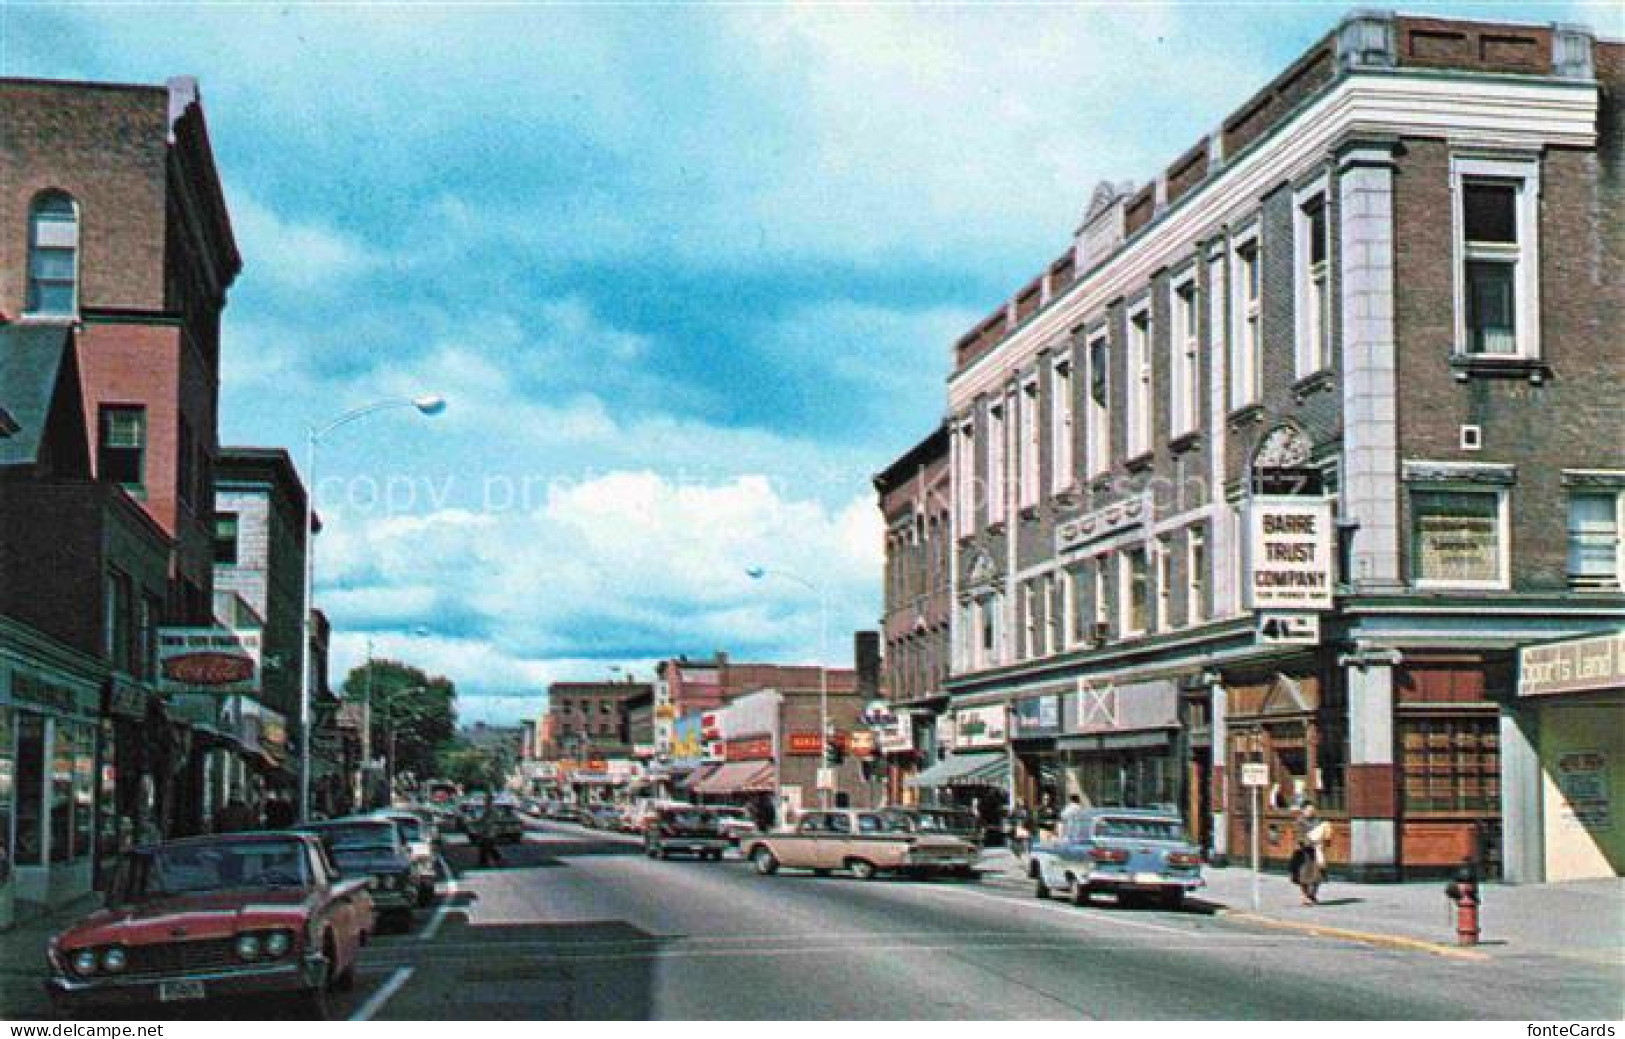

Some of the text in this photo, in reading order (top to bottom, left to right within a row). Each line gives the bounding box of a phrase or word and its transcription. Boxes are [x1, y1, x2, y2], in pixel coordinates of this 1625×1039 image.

[1262, 514, 1318, 535] BARRE
[1264, 543, 1317, 561] TRUST
[1255, 570, 1327, 588] COMPANY
